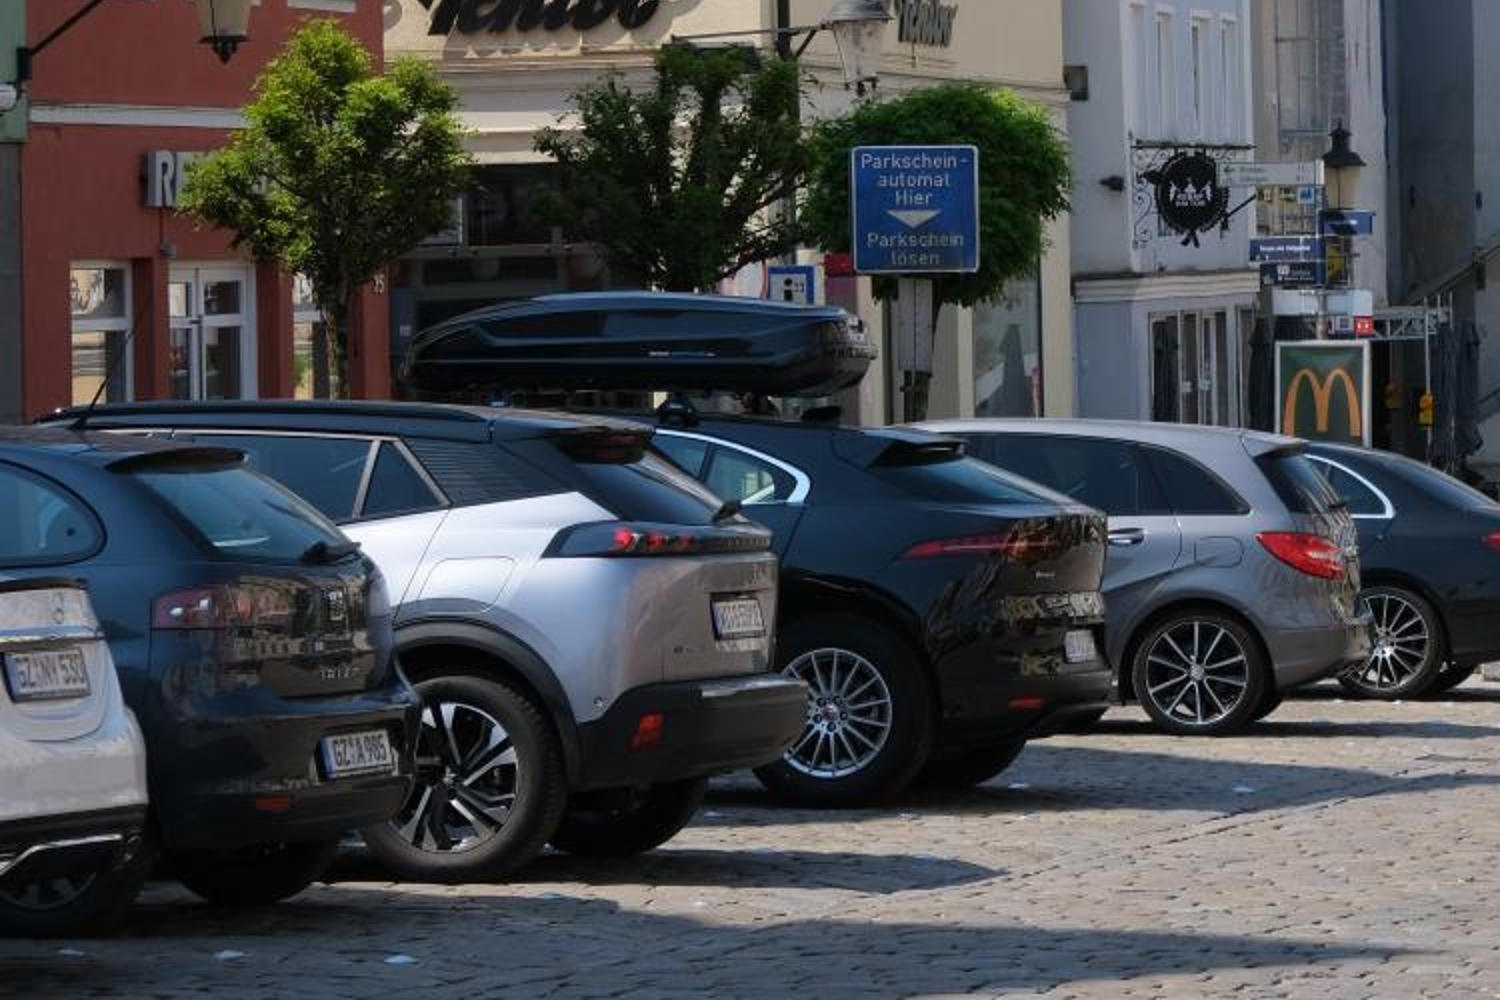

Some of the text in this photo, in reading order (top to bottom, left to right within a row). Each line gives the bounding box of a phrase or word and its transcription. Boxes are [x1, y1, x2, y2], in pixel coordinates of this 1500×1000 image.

[861, 152, 969, 169] Parkschein-
[878, 173, 951, 188] automat
[895, 190, 933, 206] Hier
[867, 232, 964, 248] Parkschein
[333, 735, 351, 767] GZ
[355, 735, 367, 765] A
